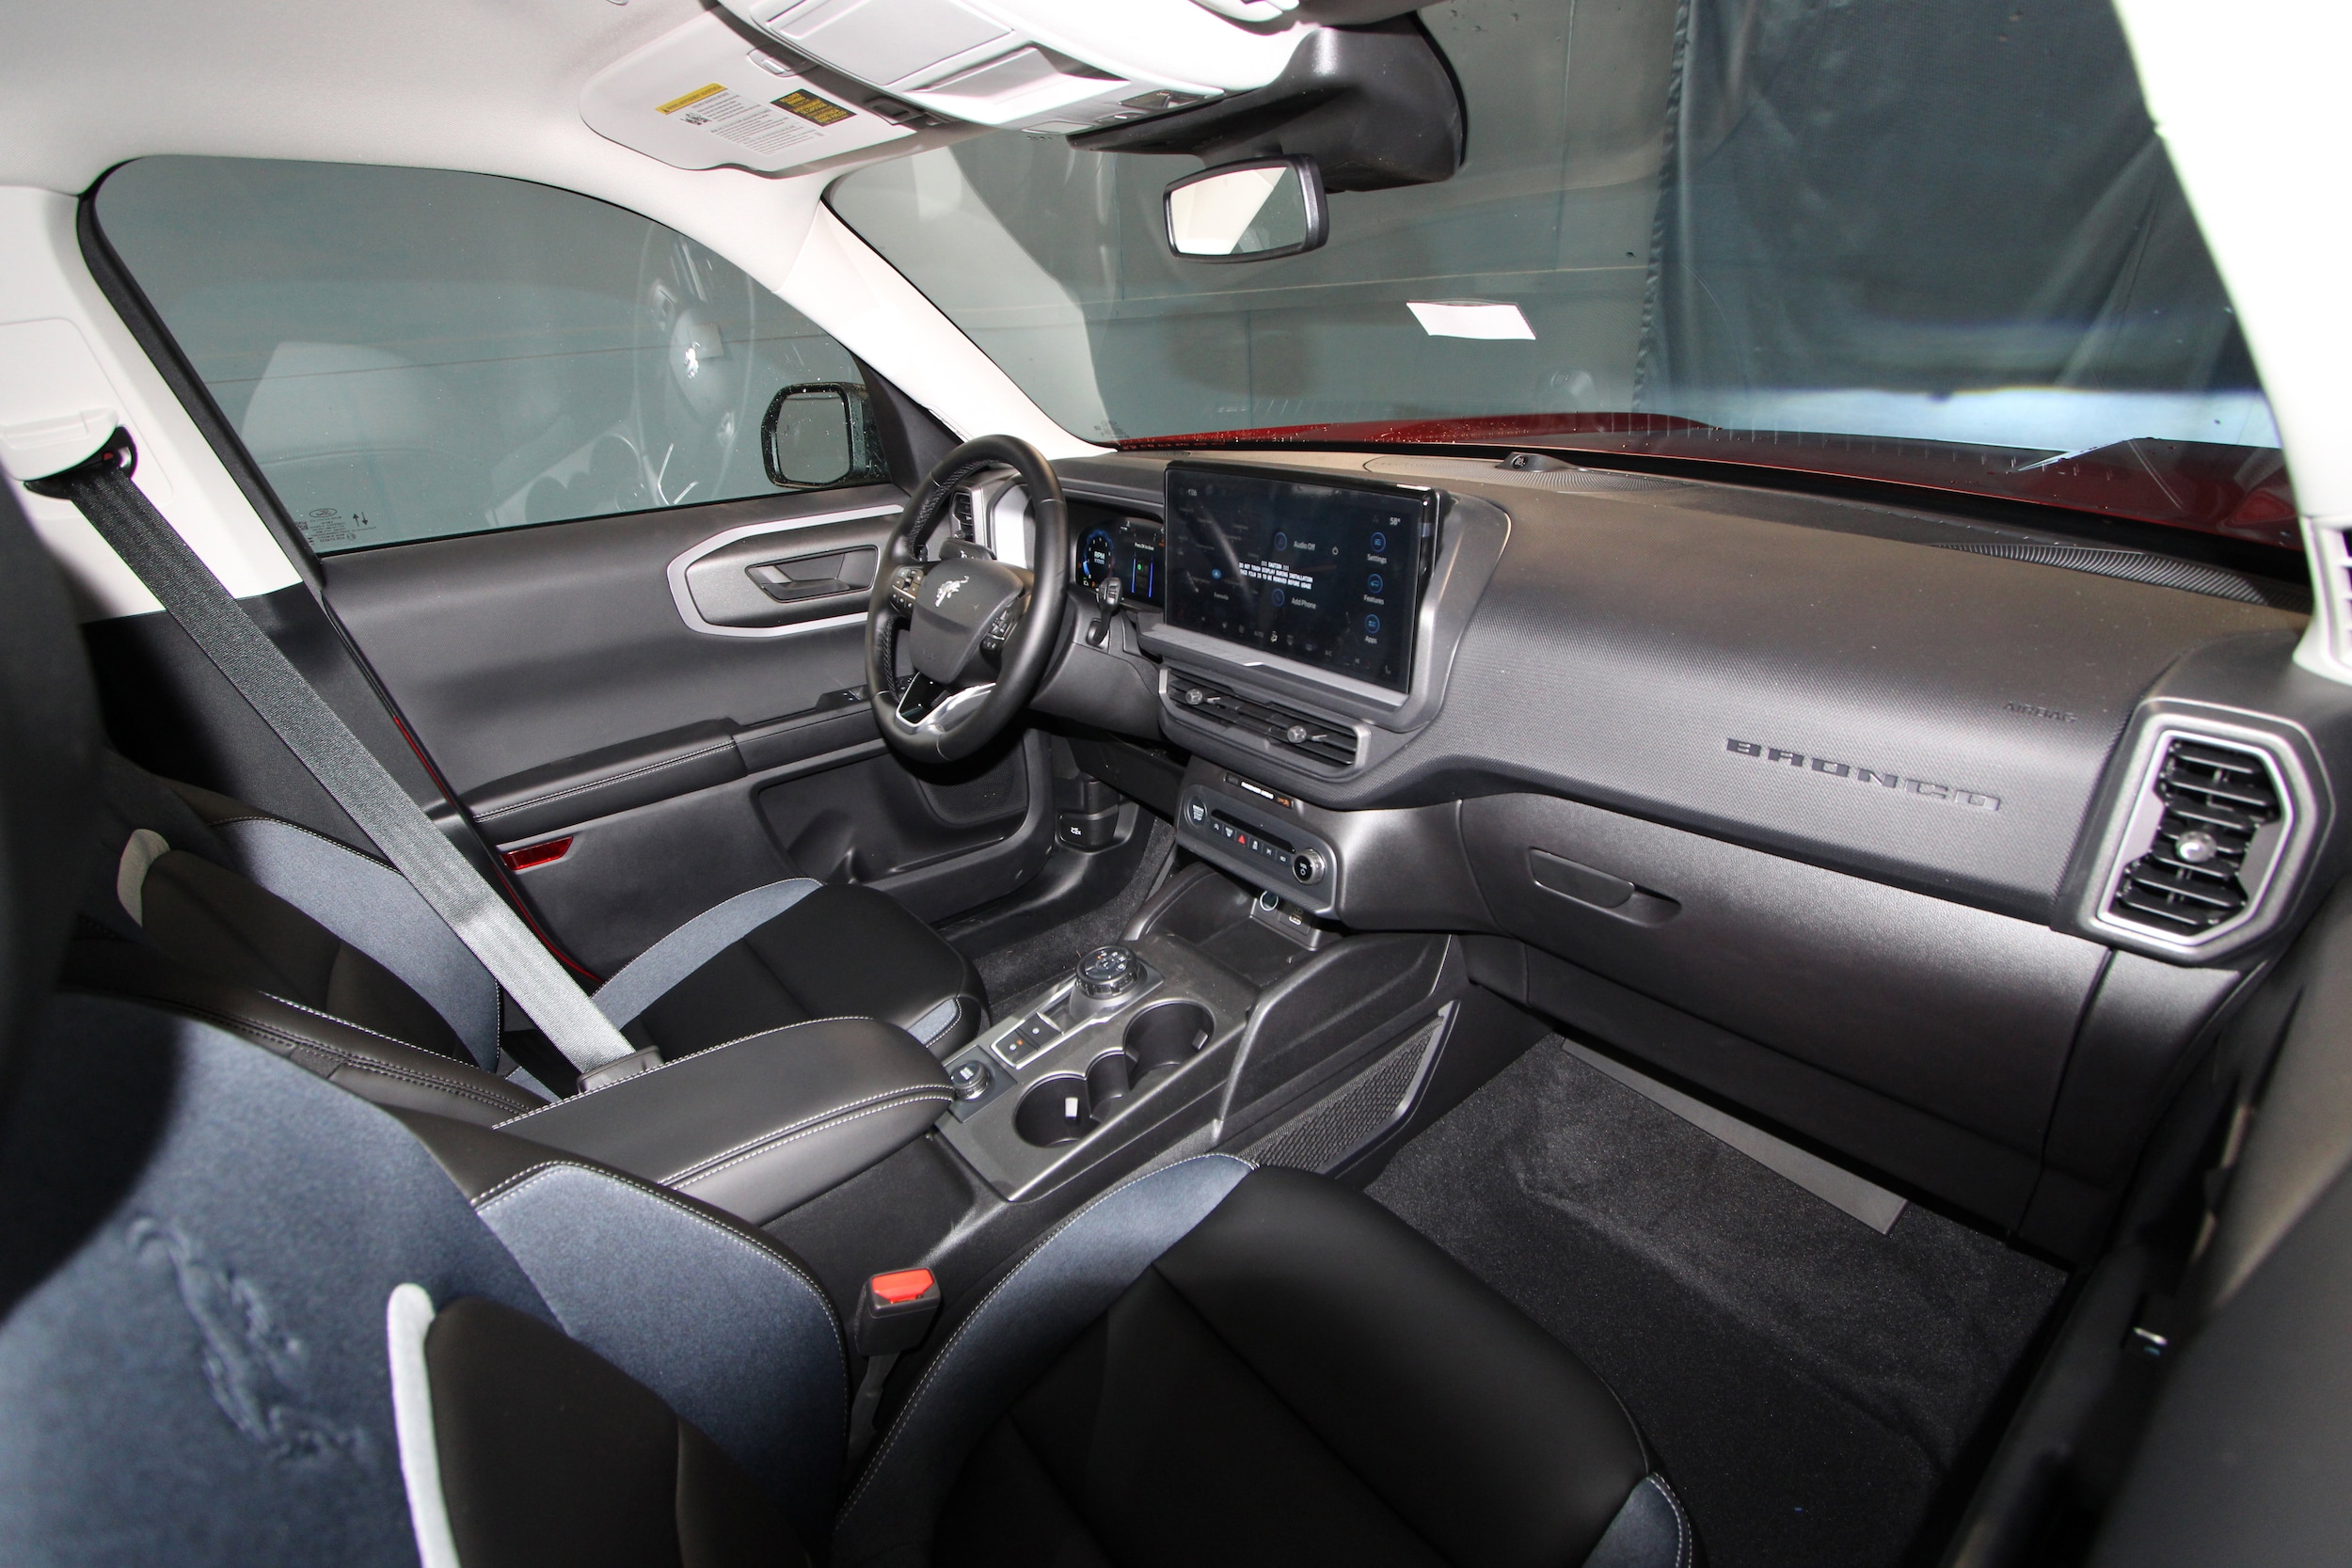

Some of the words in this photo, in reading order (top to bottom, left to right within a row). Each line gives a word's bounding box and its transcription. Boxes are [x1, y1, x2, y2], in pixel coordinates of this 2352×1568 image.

[1294, 540, 1308, 549] Audio
[1308, 543, 1316, 551] Off
[1094, 551, 1105, 560] RPM
[1367, 553, 1388, 564] Settings
[1291, 597, 1301, 607] Add
[1301, 599, 1316, 610] Phone
[1363, 594, 1385, 605] Features
[1365, 635, 1377, 644] Apps
[2003, 701, 2077, 723] AIRBAG
[1726, 737, 2001, 812] BRONCO
